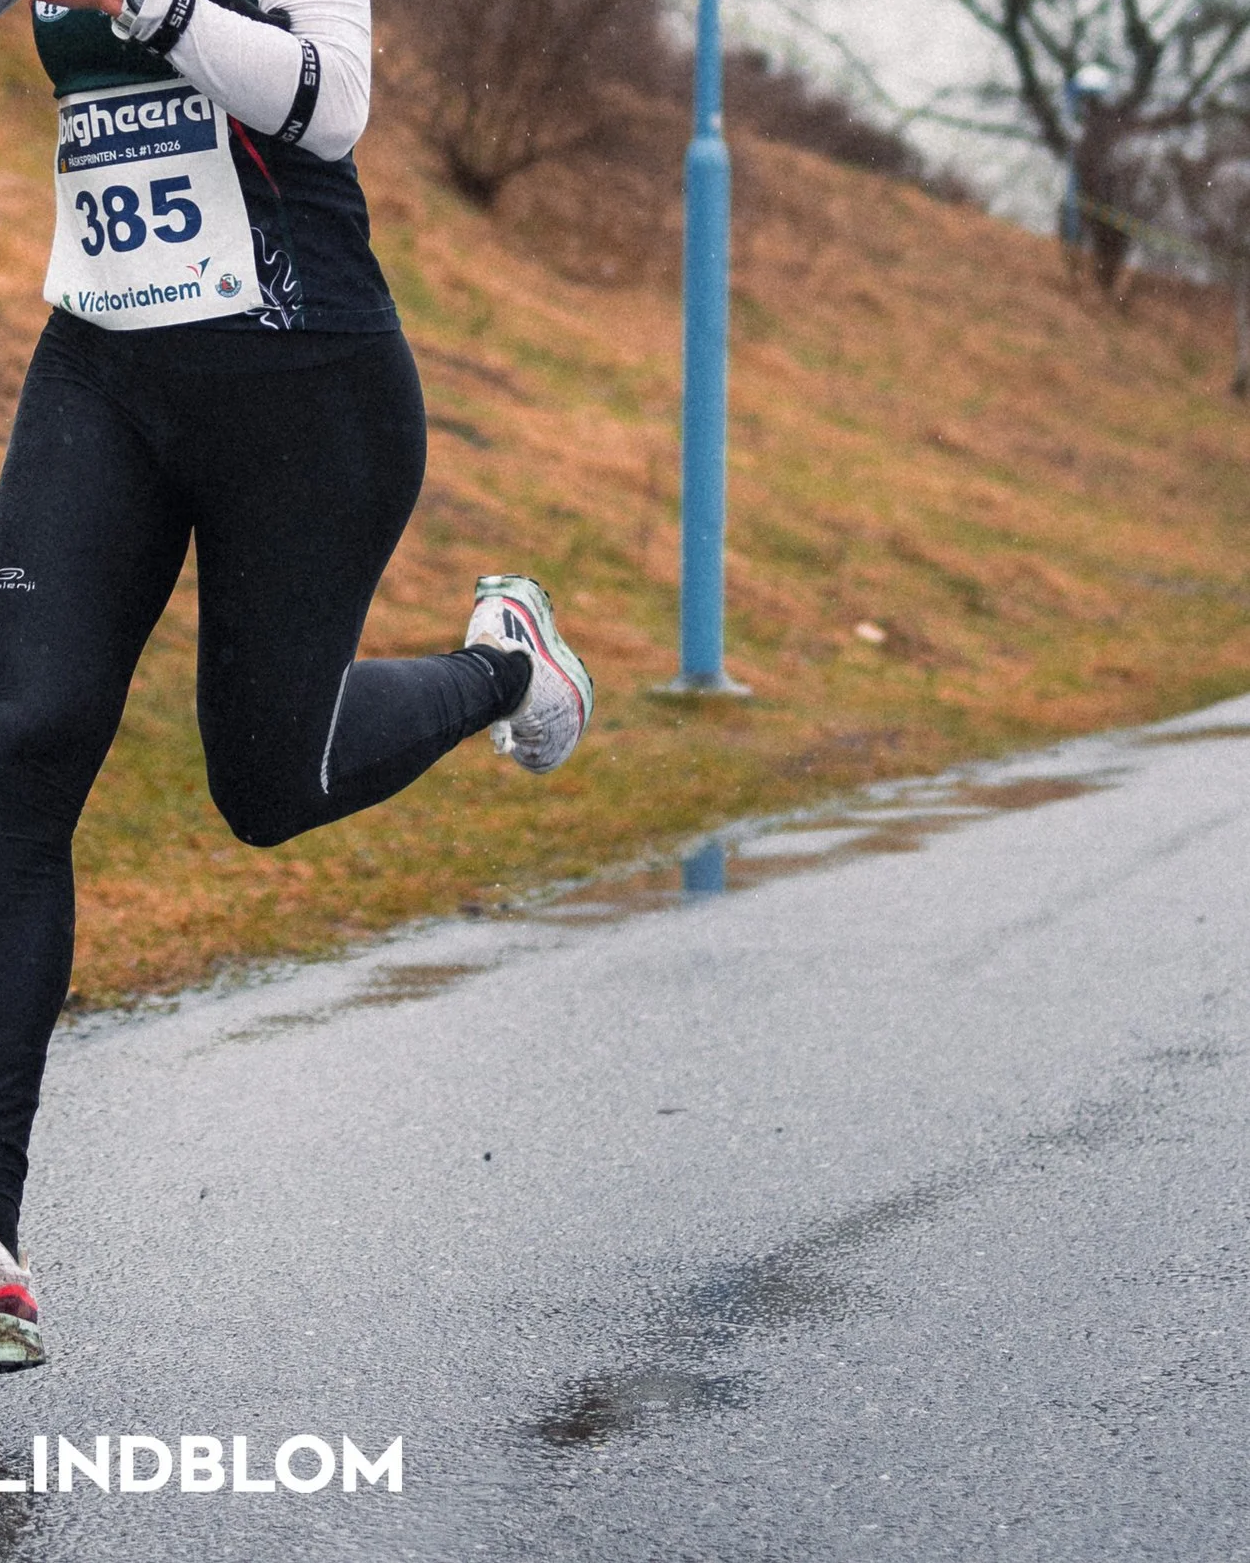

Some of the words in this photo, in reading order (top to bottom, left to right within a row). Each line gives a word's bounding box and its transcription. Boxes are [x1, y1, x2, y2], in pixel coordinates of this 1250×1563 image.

[68, 149, 117, 167] PÅSKSPRINTEN
[125, 147, 138, 159] SL
[139, 145, 151, 156] #1
[154, 139, 182, 154] 2026
[75, 174, 203, 257] 385
[78, 281, 202, 313] Victoriahem
